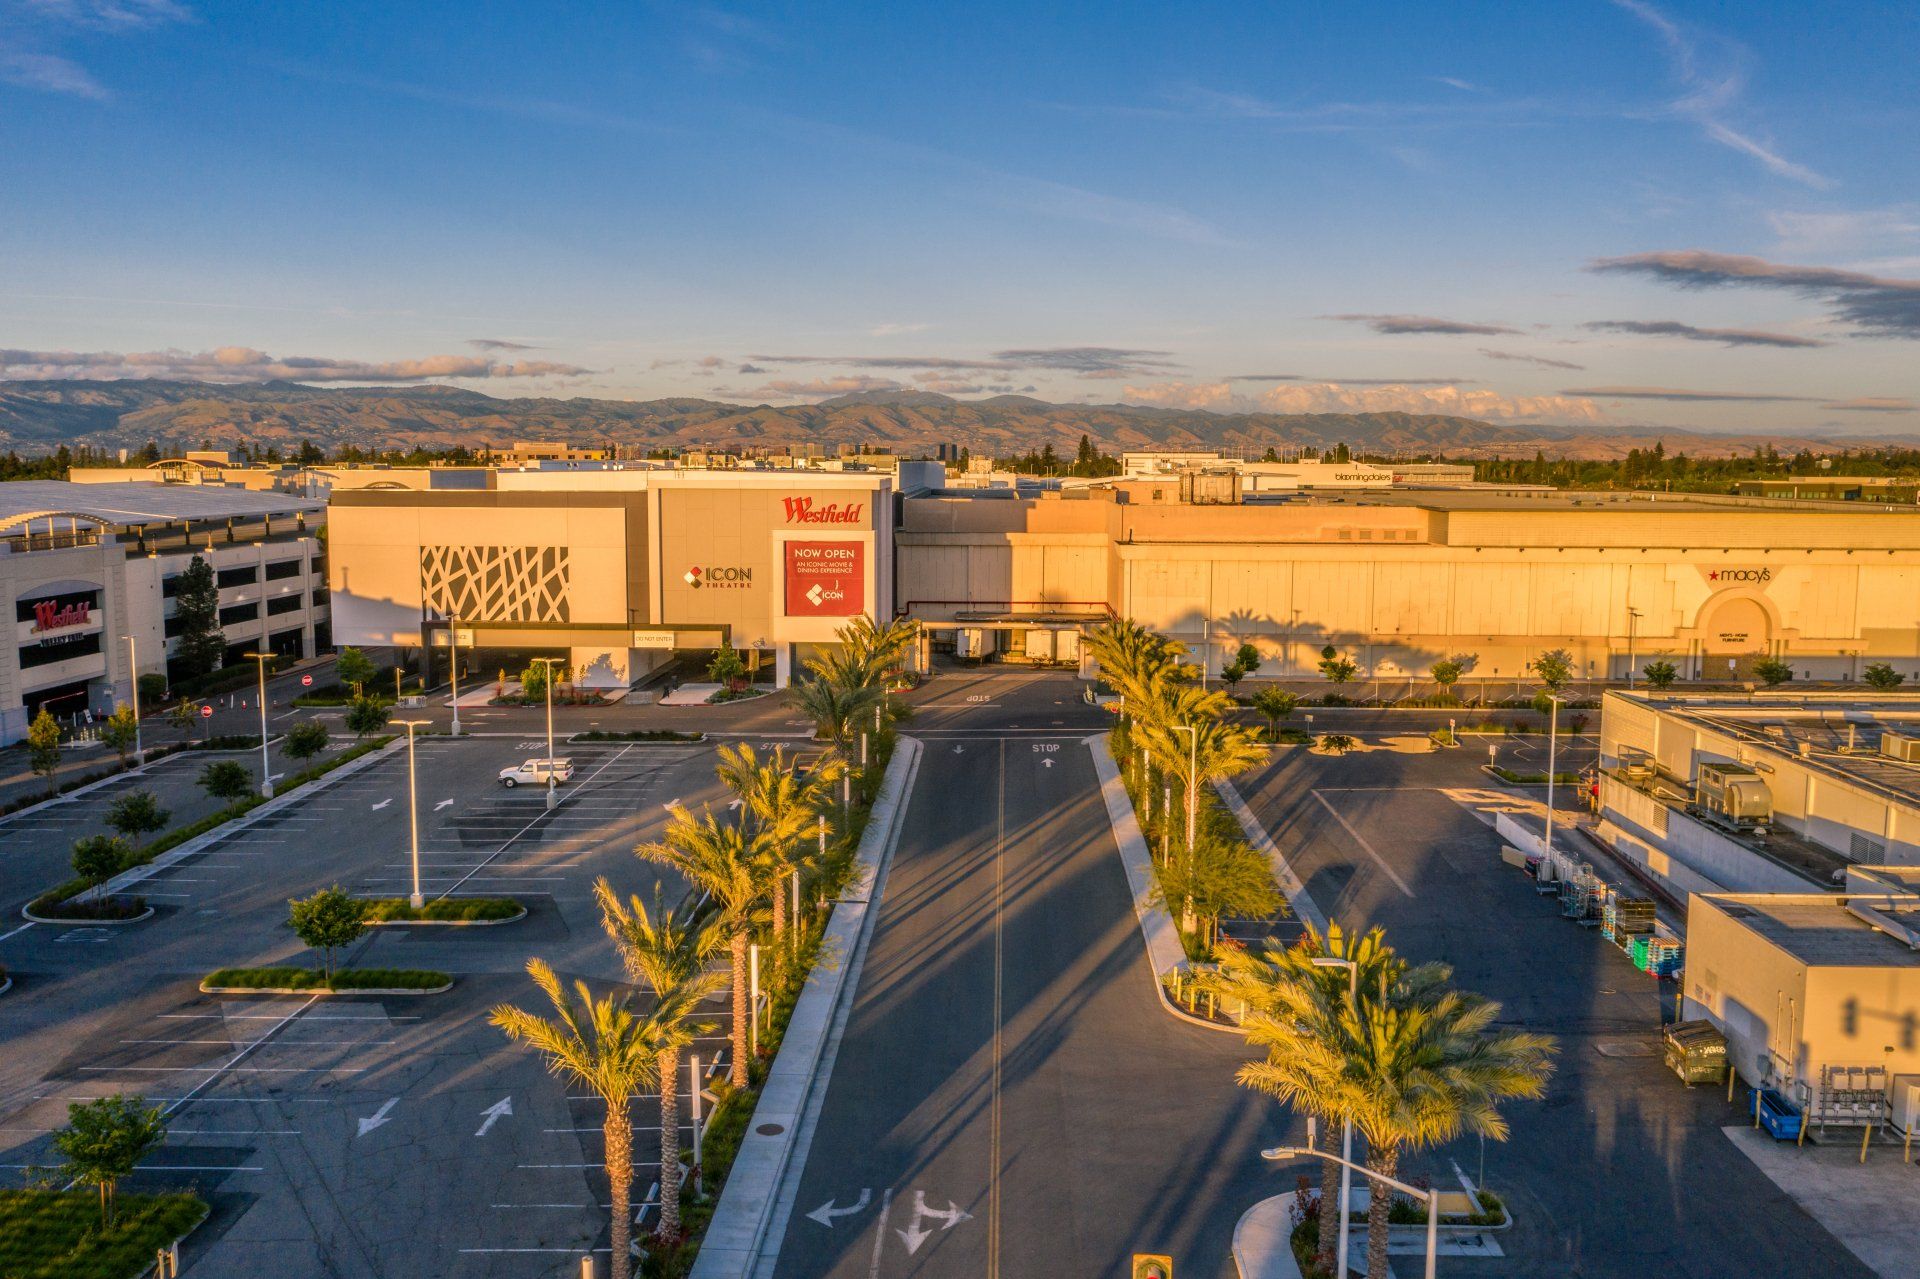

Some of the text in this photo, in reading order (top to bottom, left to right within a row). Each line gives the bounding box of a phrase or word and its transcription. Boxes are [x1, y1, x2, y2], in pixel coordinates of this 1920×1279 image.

[1335, 473, 1391, 482] bloomingdale's
[781, 496, 864, 523] Westfield
[794, 549, 855, 558] NOW OPEN
[705, 567, 752, 581] ICON
[1721, 568, 1771, 584] macy's
[822, 591, 844, 599] ICON
[32, 600, 90, 630] Westfield
[514, 742, 548, 750] STOP
[1032, 744, 1060, 752] STOP
